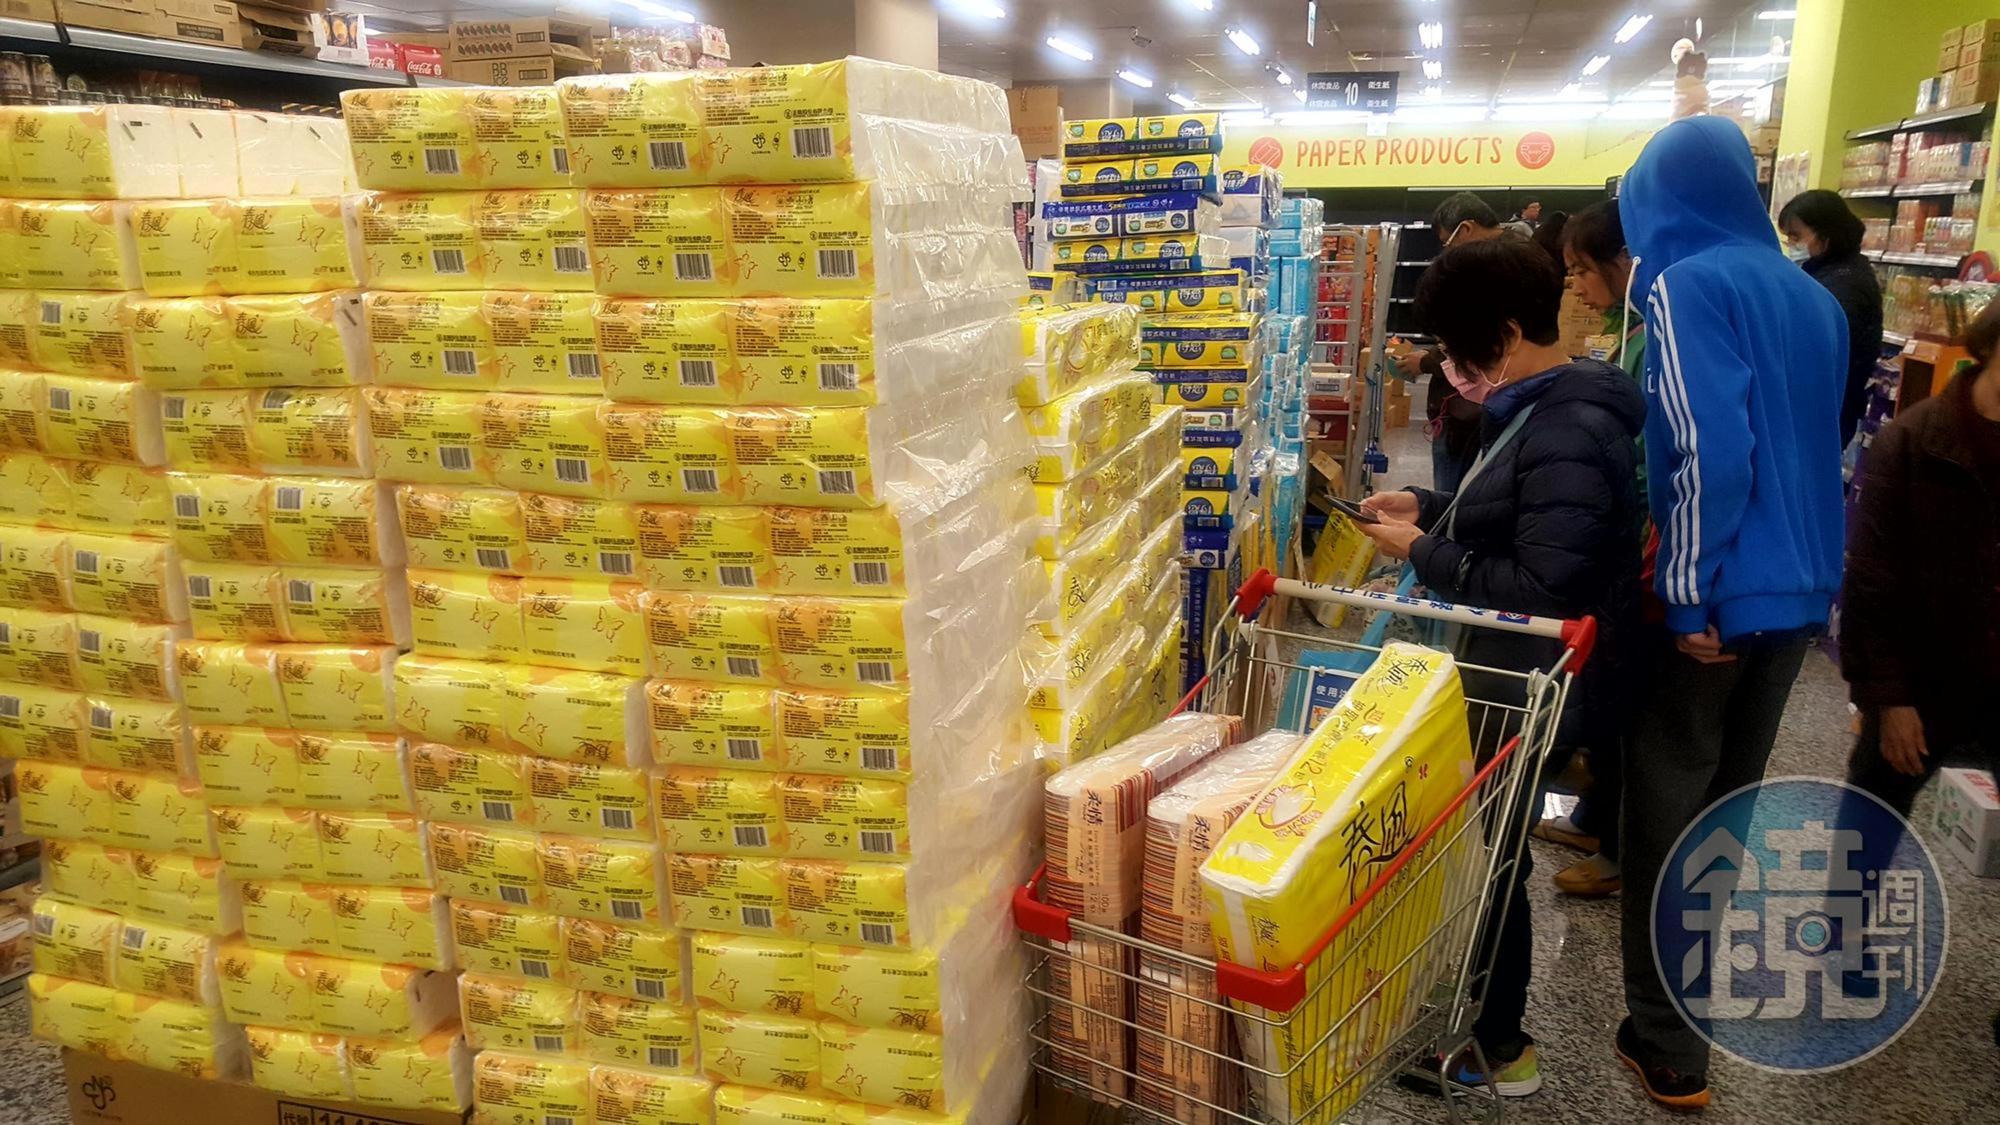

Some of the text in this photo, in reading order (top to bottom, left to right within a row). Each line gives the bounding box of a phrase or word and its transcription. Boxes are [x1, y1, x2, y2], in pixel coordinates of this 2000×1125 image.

[406, 61, 432, 74] Coca-Cola
[1344, 81, 1360, 106] 10
[1296, 136, 1504, 168] PAPER PRODUCTS
[1086, 789, 1104, 825] 柔情
[1192, 815, 1211, 851] 柔情
[1339, 781, 1420, 905] 春風
